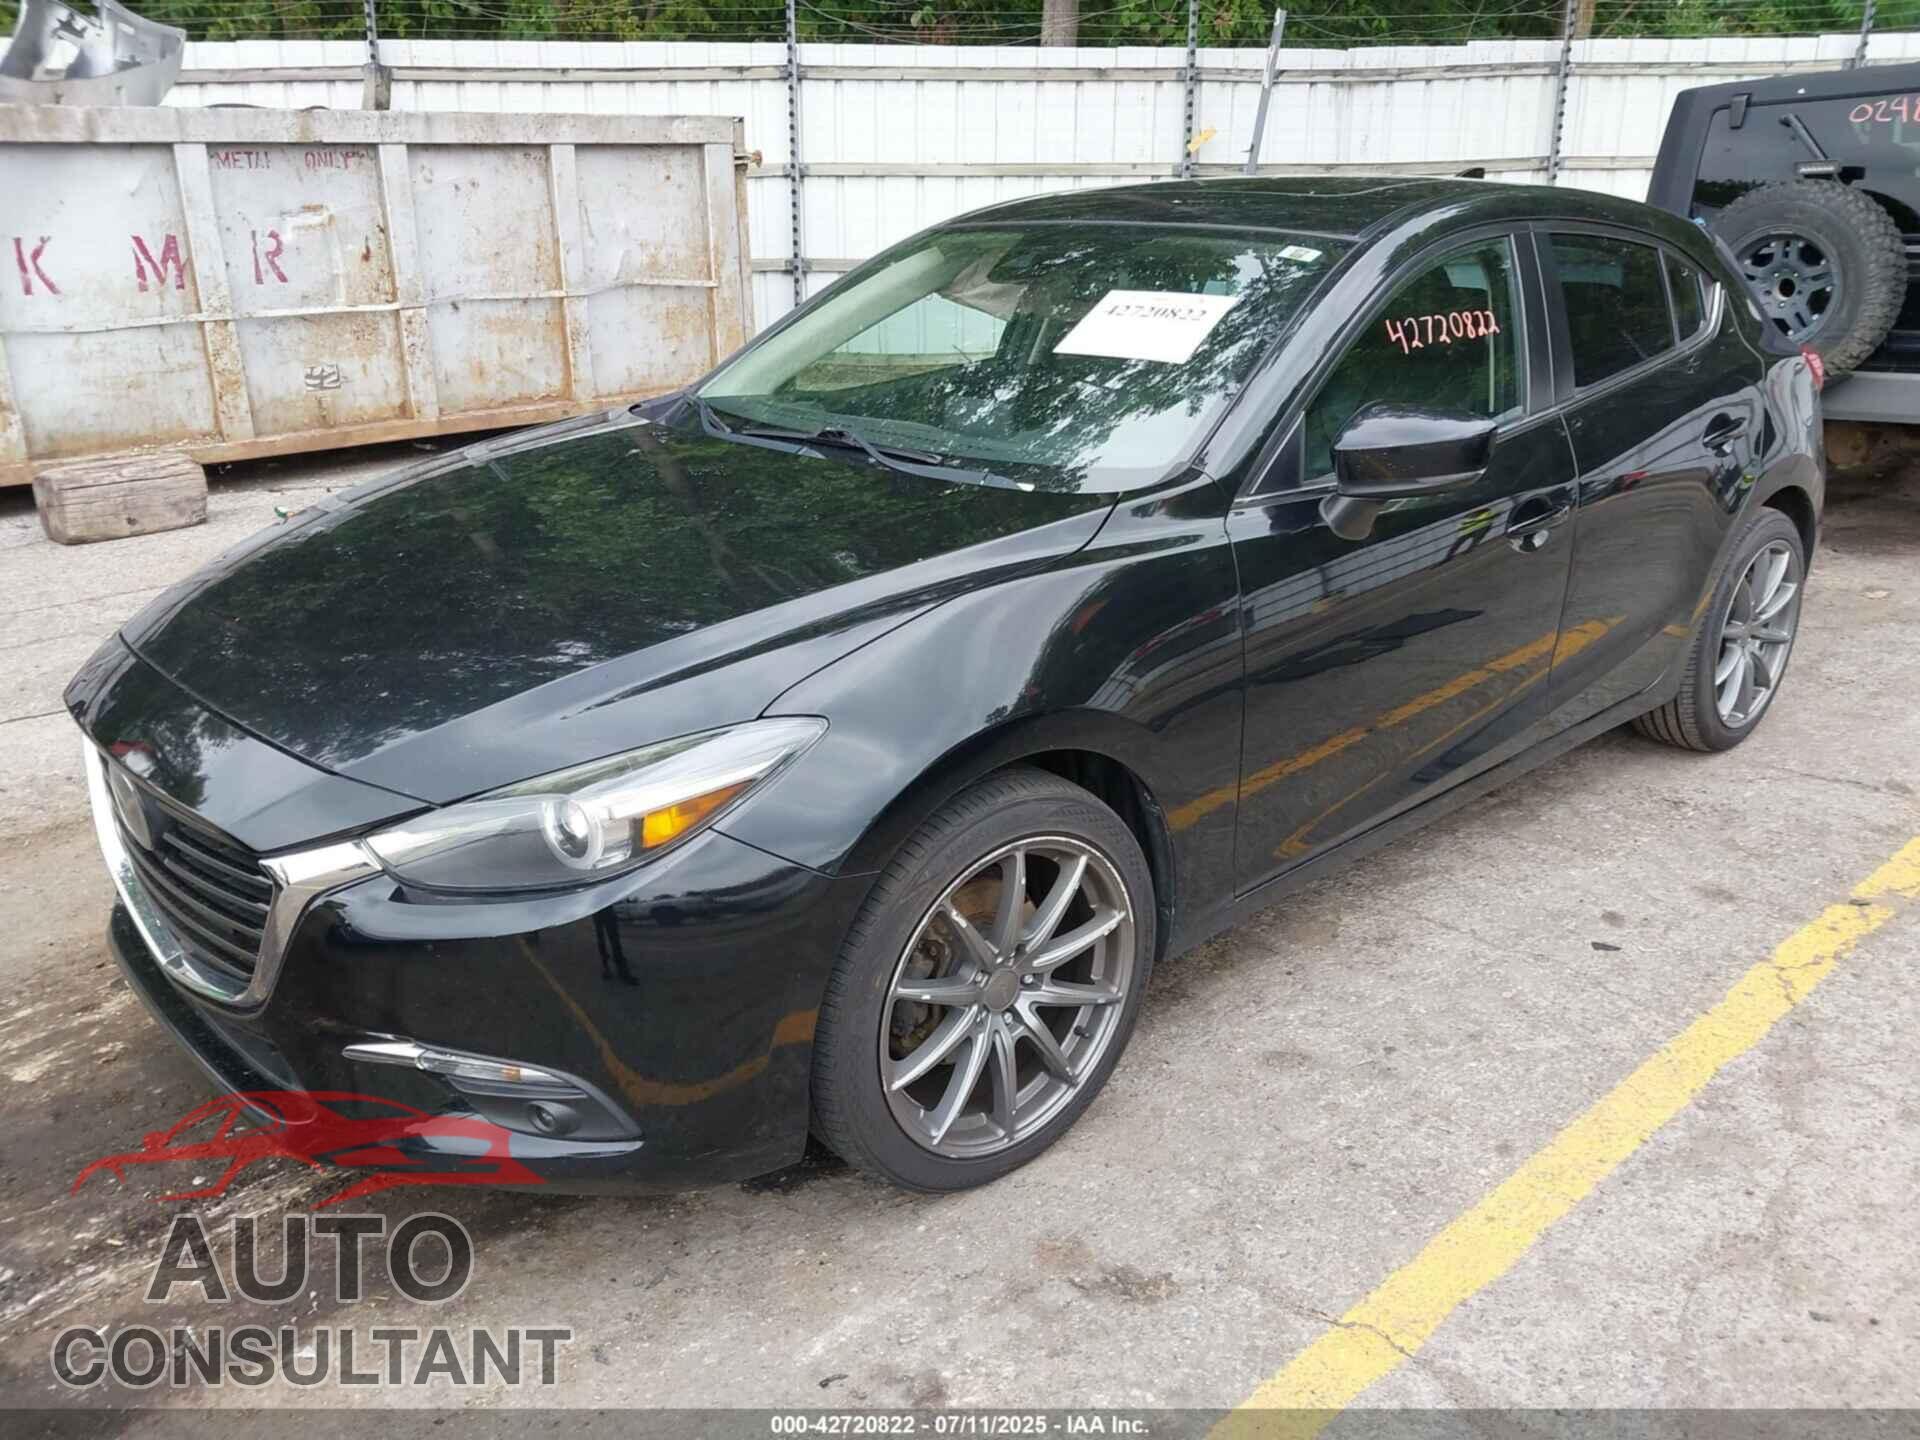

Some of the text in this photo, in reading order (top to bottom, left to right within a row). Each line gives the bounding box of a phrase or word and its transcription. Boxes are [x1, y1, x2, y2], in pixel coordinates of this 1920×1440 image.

[12, 228, 289, 297] K M R
[1385, 309, 1501, 355] 42720822
